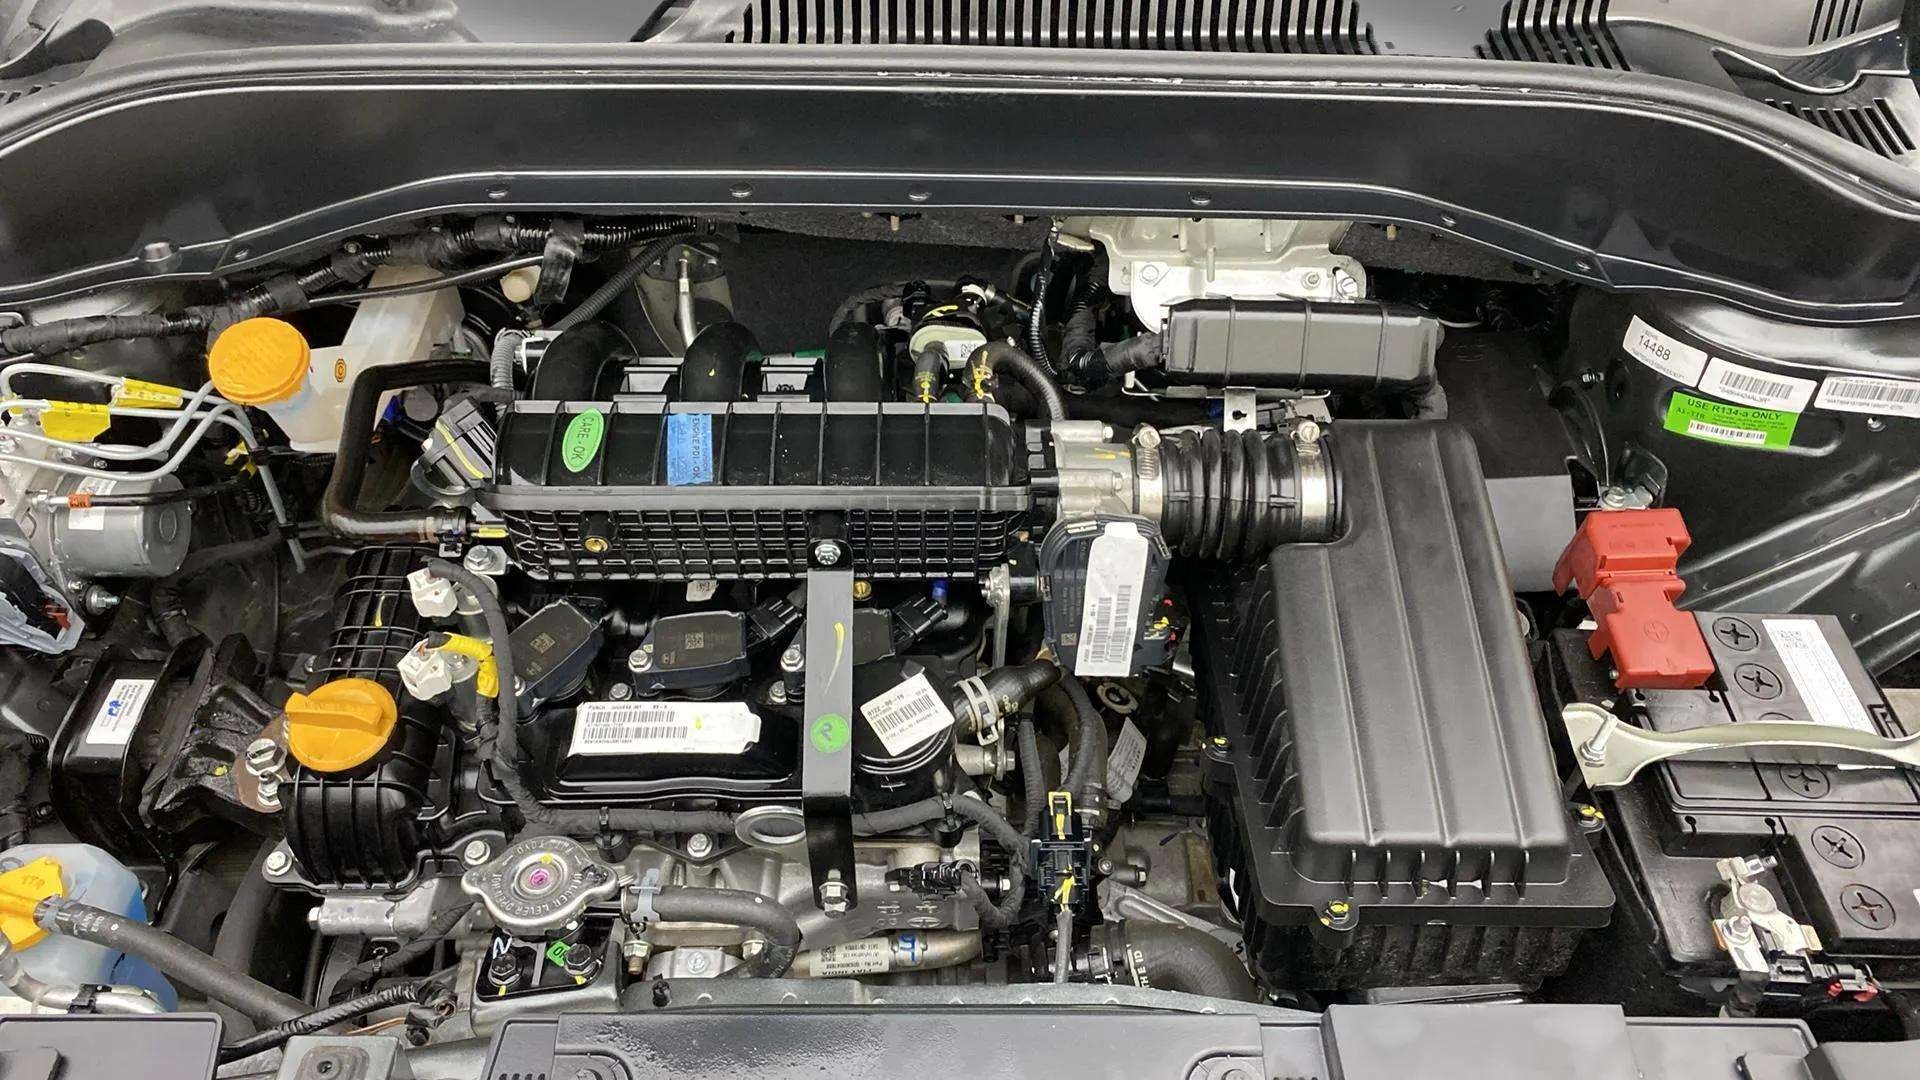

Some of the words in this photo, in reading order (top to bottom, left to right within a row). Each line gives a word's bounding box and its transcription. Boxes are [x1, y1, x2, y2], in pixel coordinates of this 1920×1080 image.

[1638, 335, 1671, 361] 14488
[1687, 398, 1709, 410] USE
[1752, 411, 1782, 420] ONLY
[576, 417, 595, 438] CARE
[572, 446, 586, 462] OK
